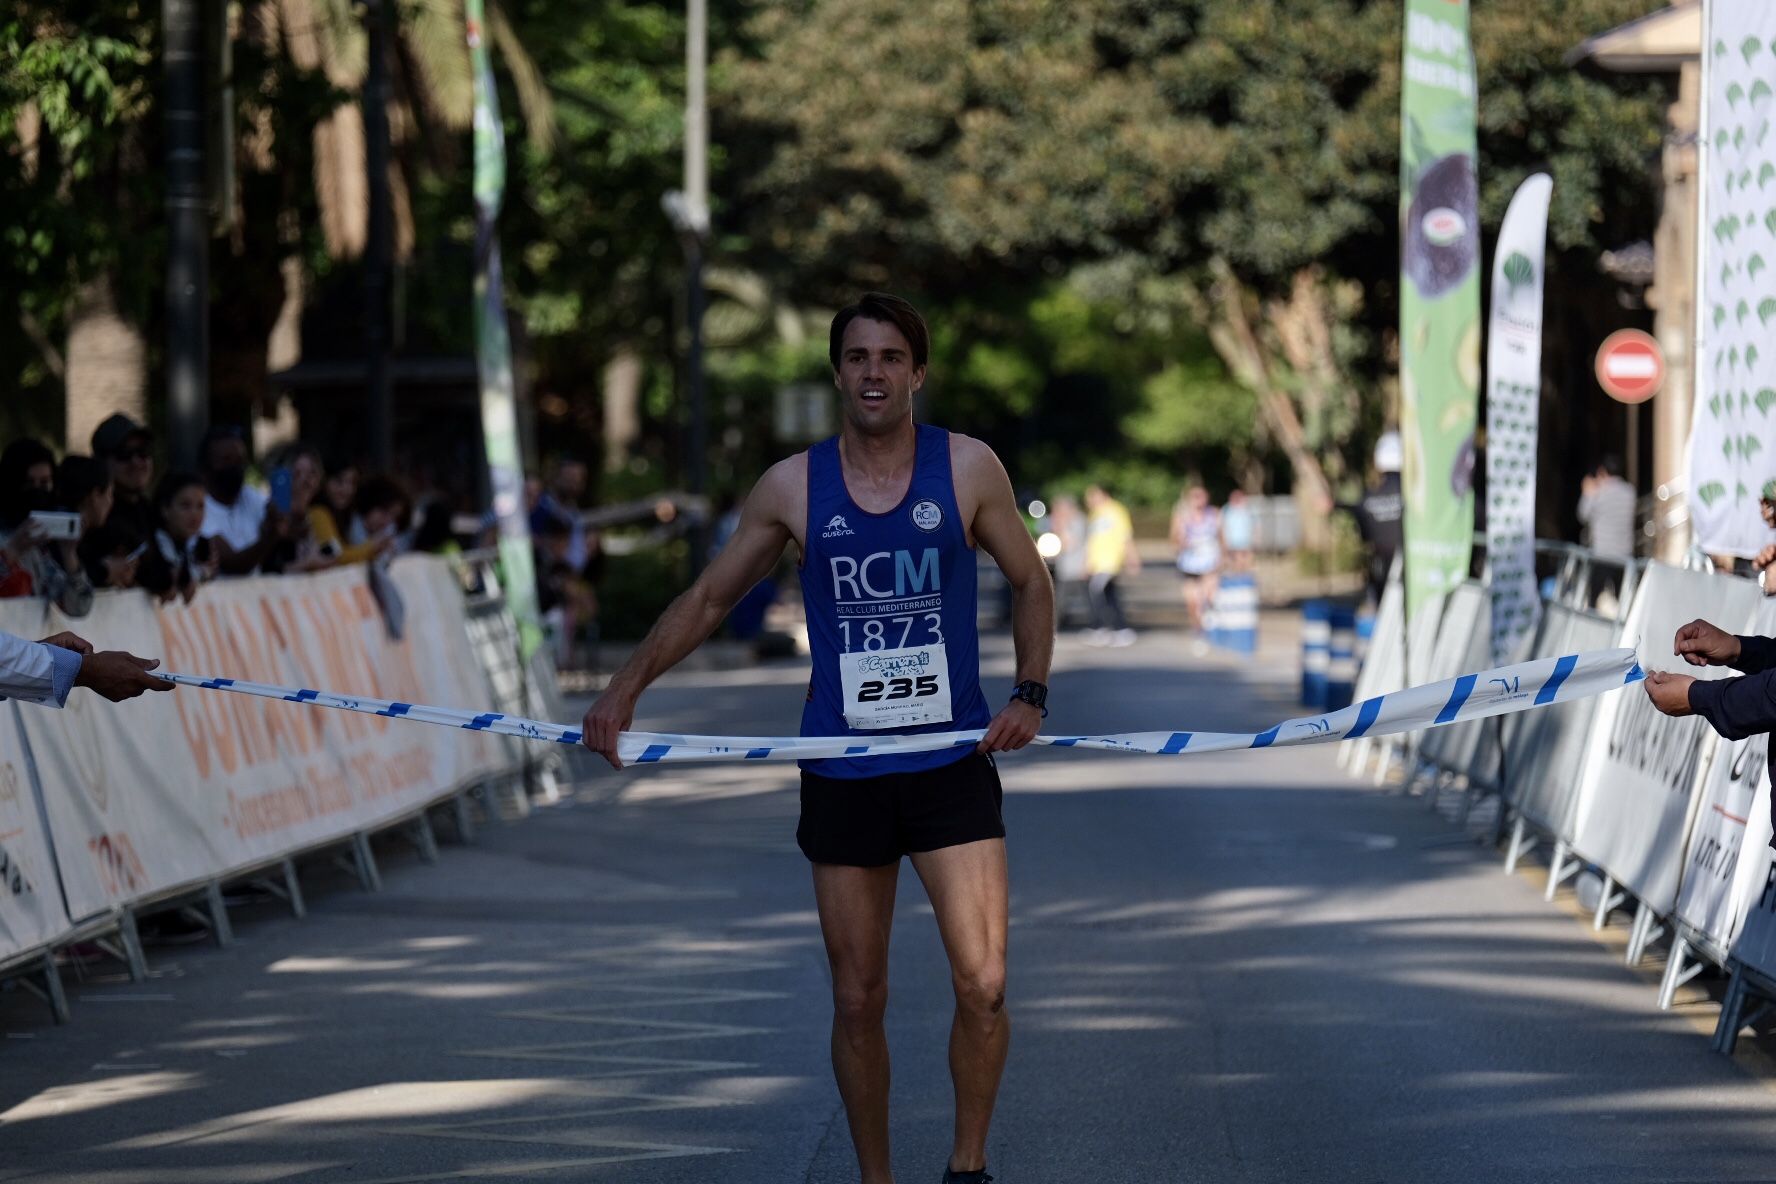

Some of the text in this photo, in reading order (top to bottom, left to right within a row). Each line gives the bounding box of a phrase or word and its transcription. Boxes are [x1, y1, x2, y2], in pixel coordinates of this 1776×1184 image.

[916, 510, 939, 520] RCM
[830, 547, 941, 600] RCM
[836, 606, 855, 614] REAL
[856, 604, 876, 614] CLUB
[838, 613, 943, 653] 1873
[857, 674, 938, 702] 235
